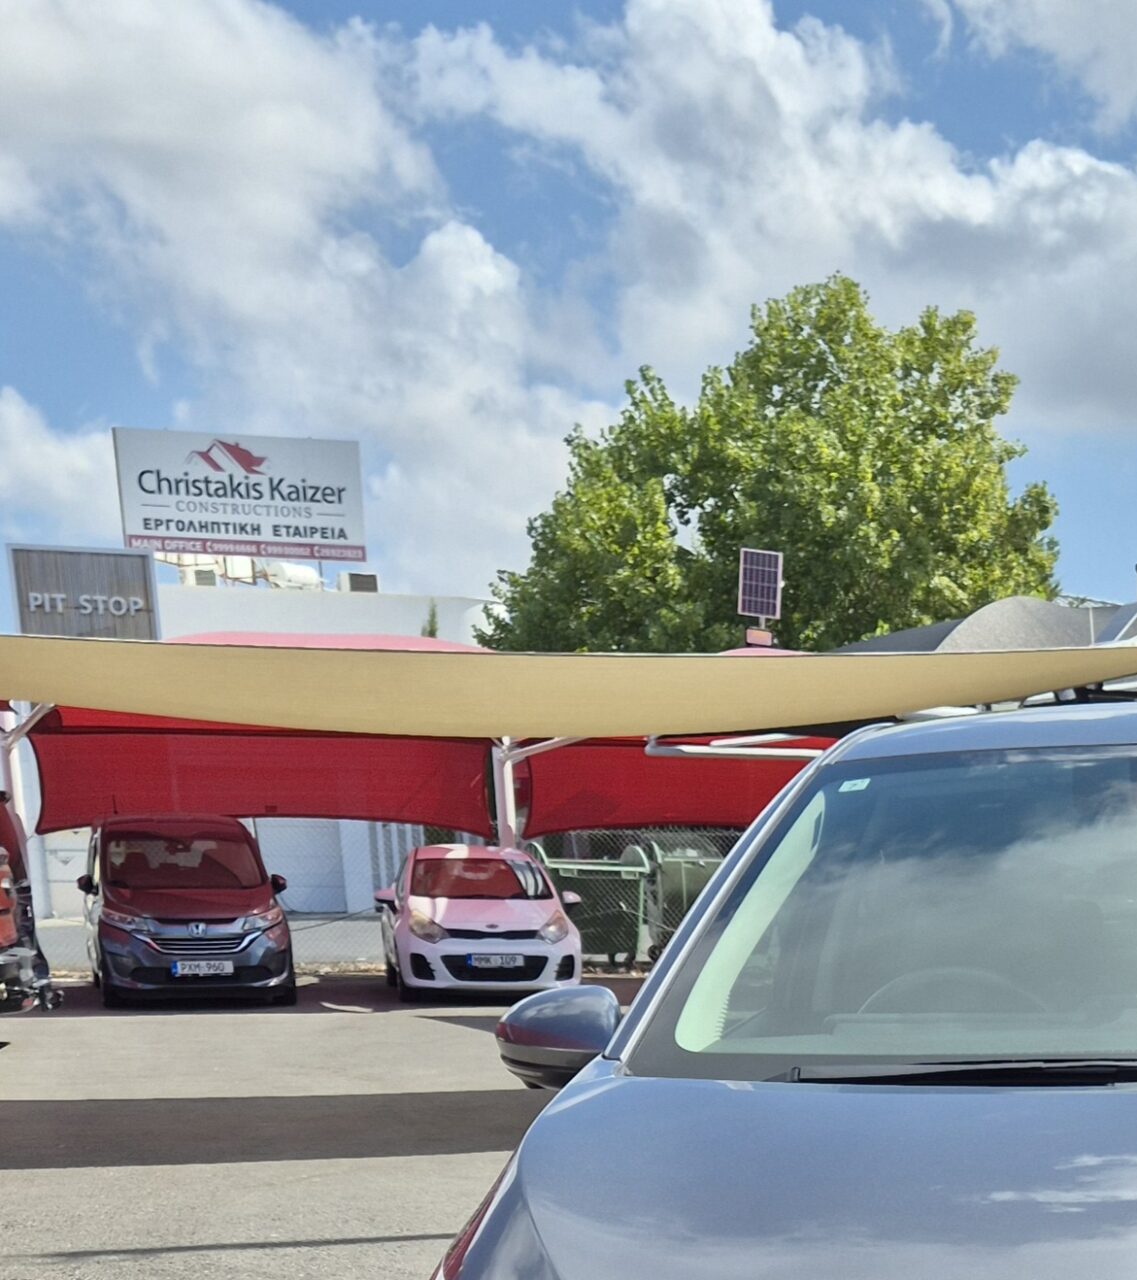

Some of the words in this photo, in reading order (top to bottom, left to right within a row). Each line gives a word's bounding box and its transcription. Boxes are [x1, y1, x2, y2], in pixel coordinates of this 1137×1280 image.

[137, 469, 263, 502] Christakis
[269, 477, 347, 505] Kaizer
[175, 500, 313, 519] CONSTRUCTIONS
[142, 518, 261, 536] ΕΡΓΟΛΗΠΤΙΚΗ
[272, 524, 349, 541] ΕΤΑΙΡΕΙΑ
[131, 537, 163, 551] MAIN
[164, 540, 203, 552] OFFICE
[28, 592, 67, 613] PIT
[78, 594, 145, 617] STOP
